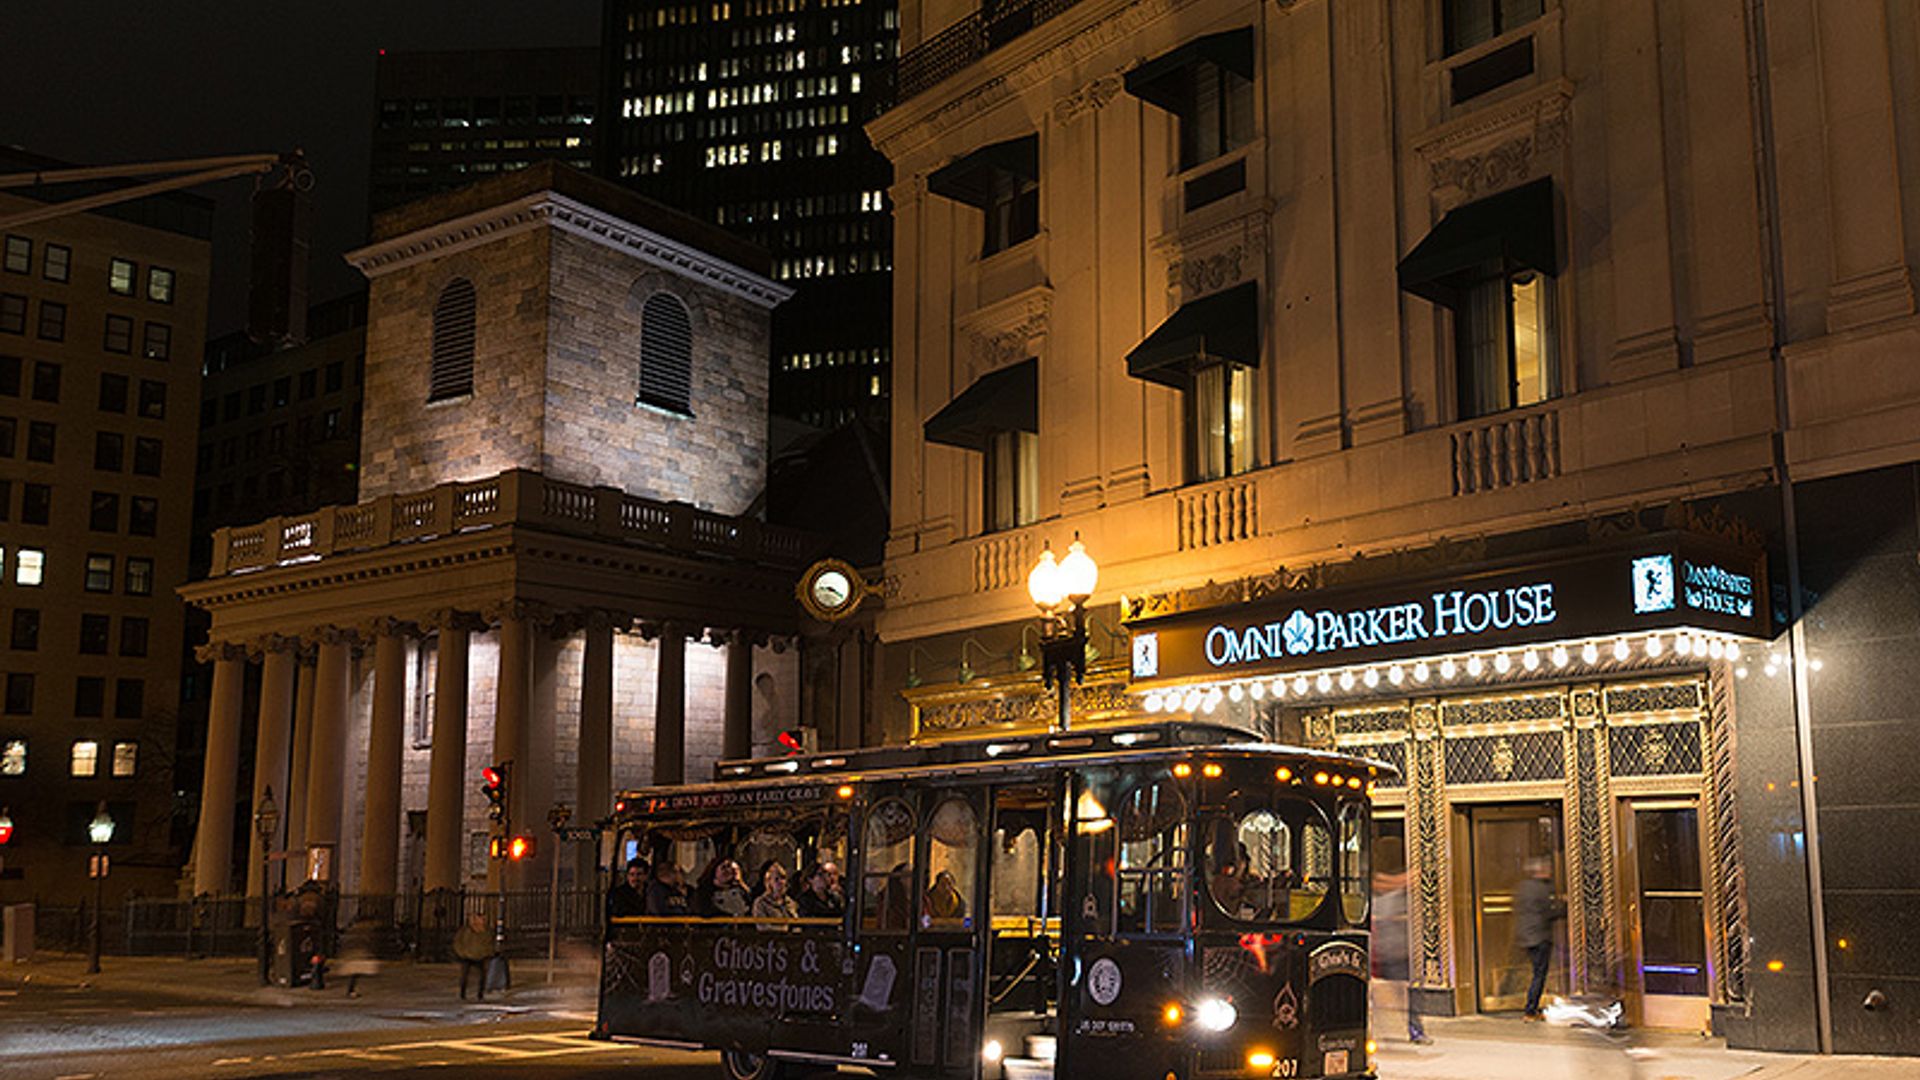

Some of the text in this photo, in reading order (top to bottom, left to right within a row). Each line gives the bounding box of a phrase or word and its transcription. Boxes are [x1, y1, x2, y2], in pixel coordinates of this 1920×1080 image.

[1205, 583, 1557, 666] OMNI PARKER HOUSE
[715, 936, 820, 973] Ghosts &
[698, 972, 835, 1014] Gravestones
[1272, 1058, 1298, 1078] 207
